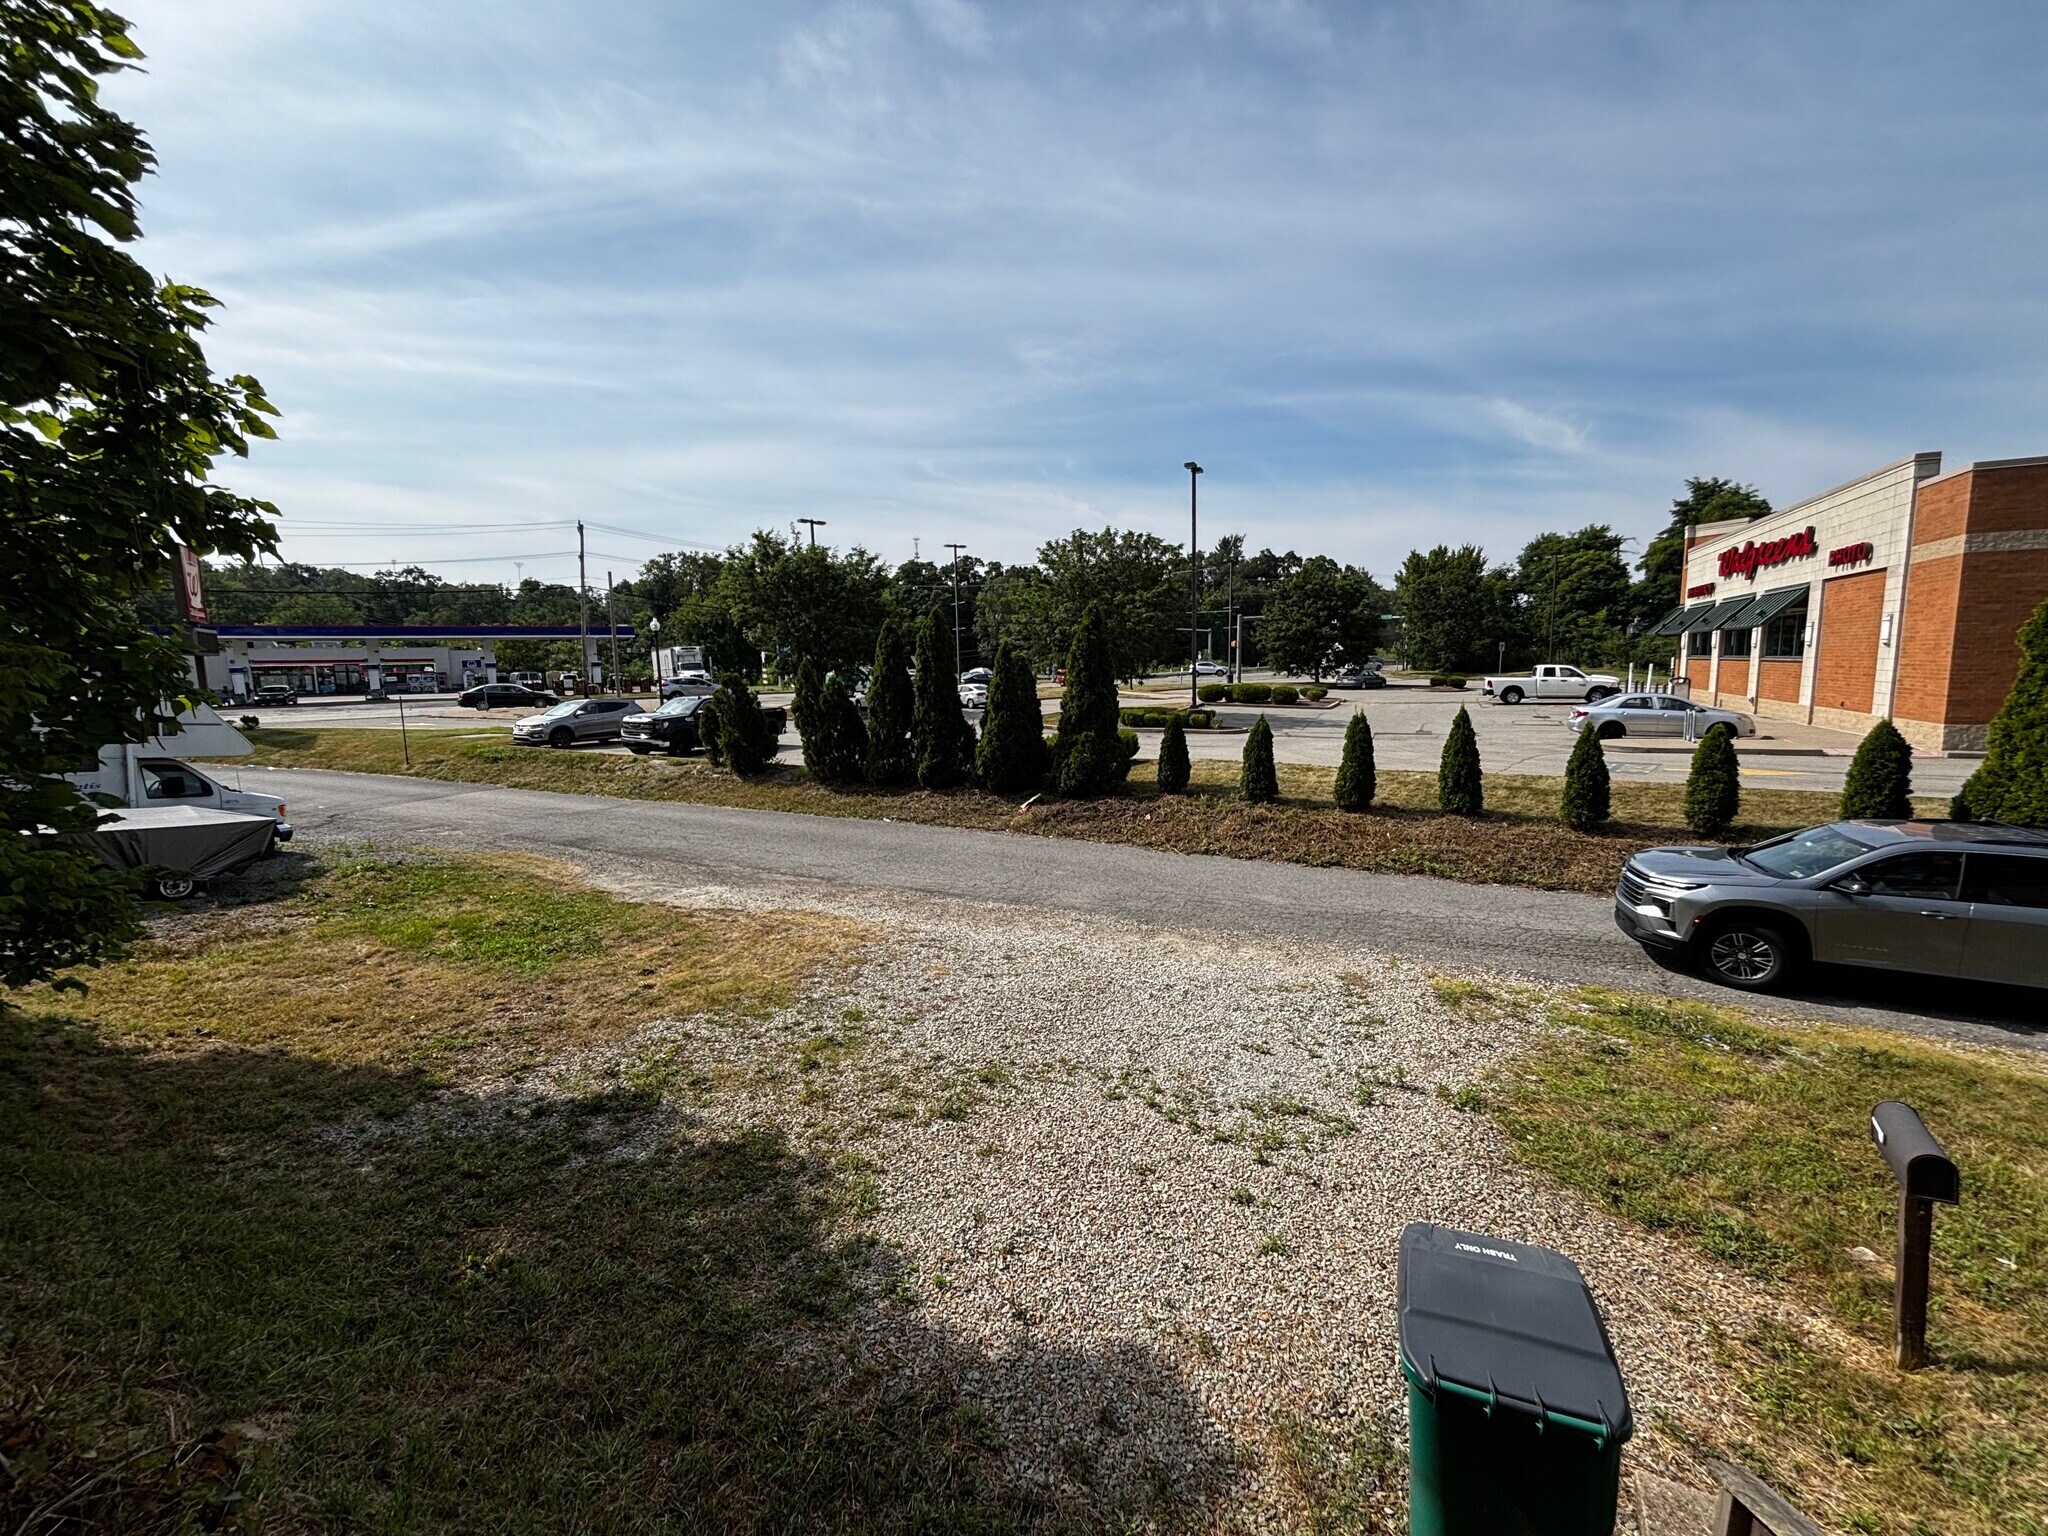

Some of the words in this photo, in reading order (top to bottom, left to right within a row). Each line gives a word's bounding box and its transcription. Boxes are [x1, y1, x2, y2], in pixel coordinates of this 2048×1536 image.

[1717, 525, 1818, 580] Walgreens
[1828, 542, 1873, 567] PHOTO
[1454, 1242, 1481, 1253] ONLY
[1482, 1247, 1518, 1262] TRASH
